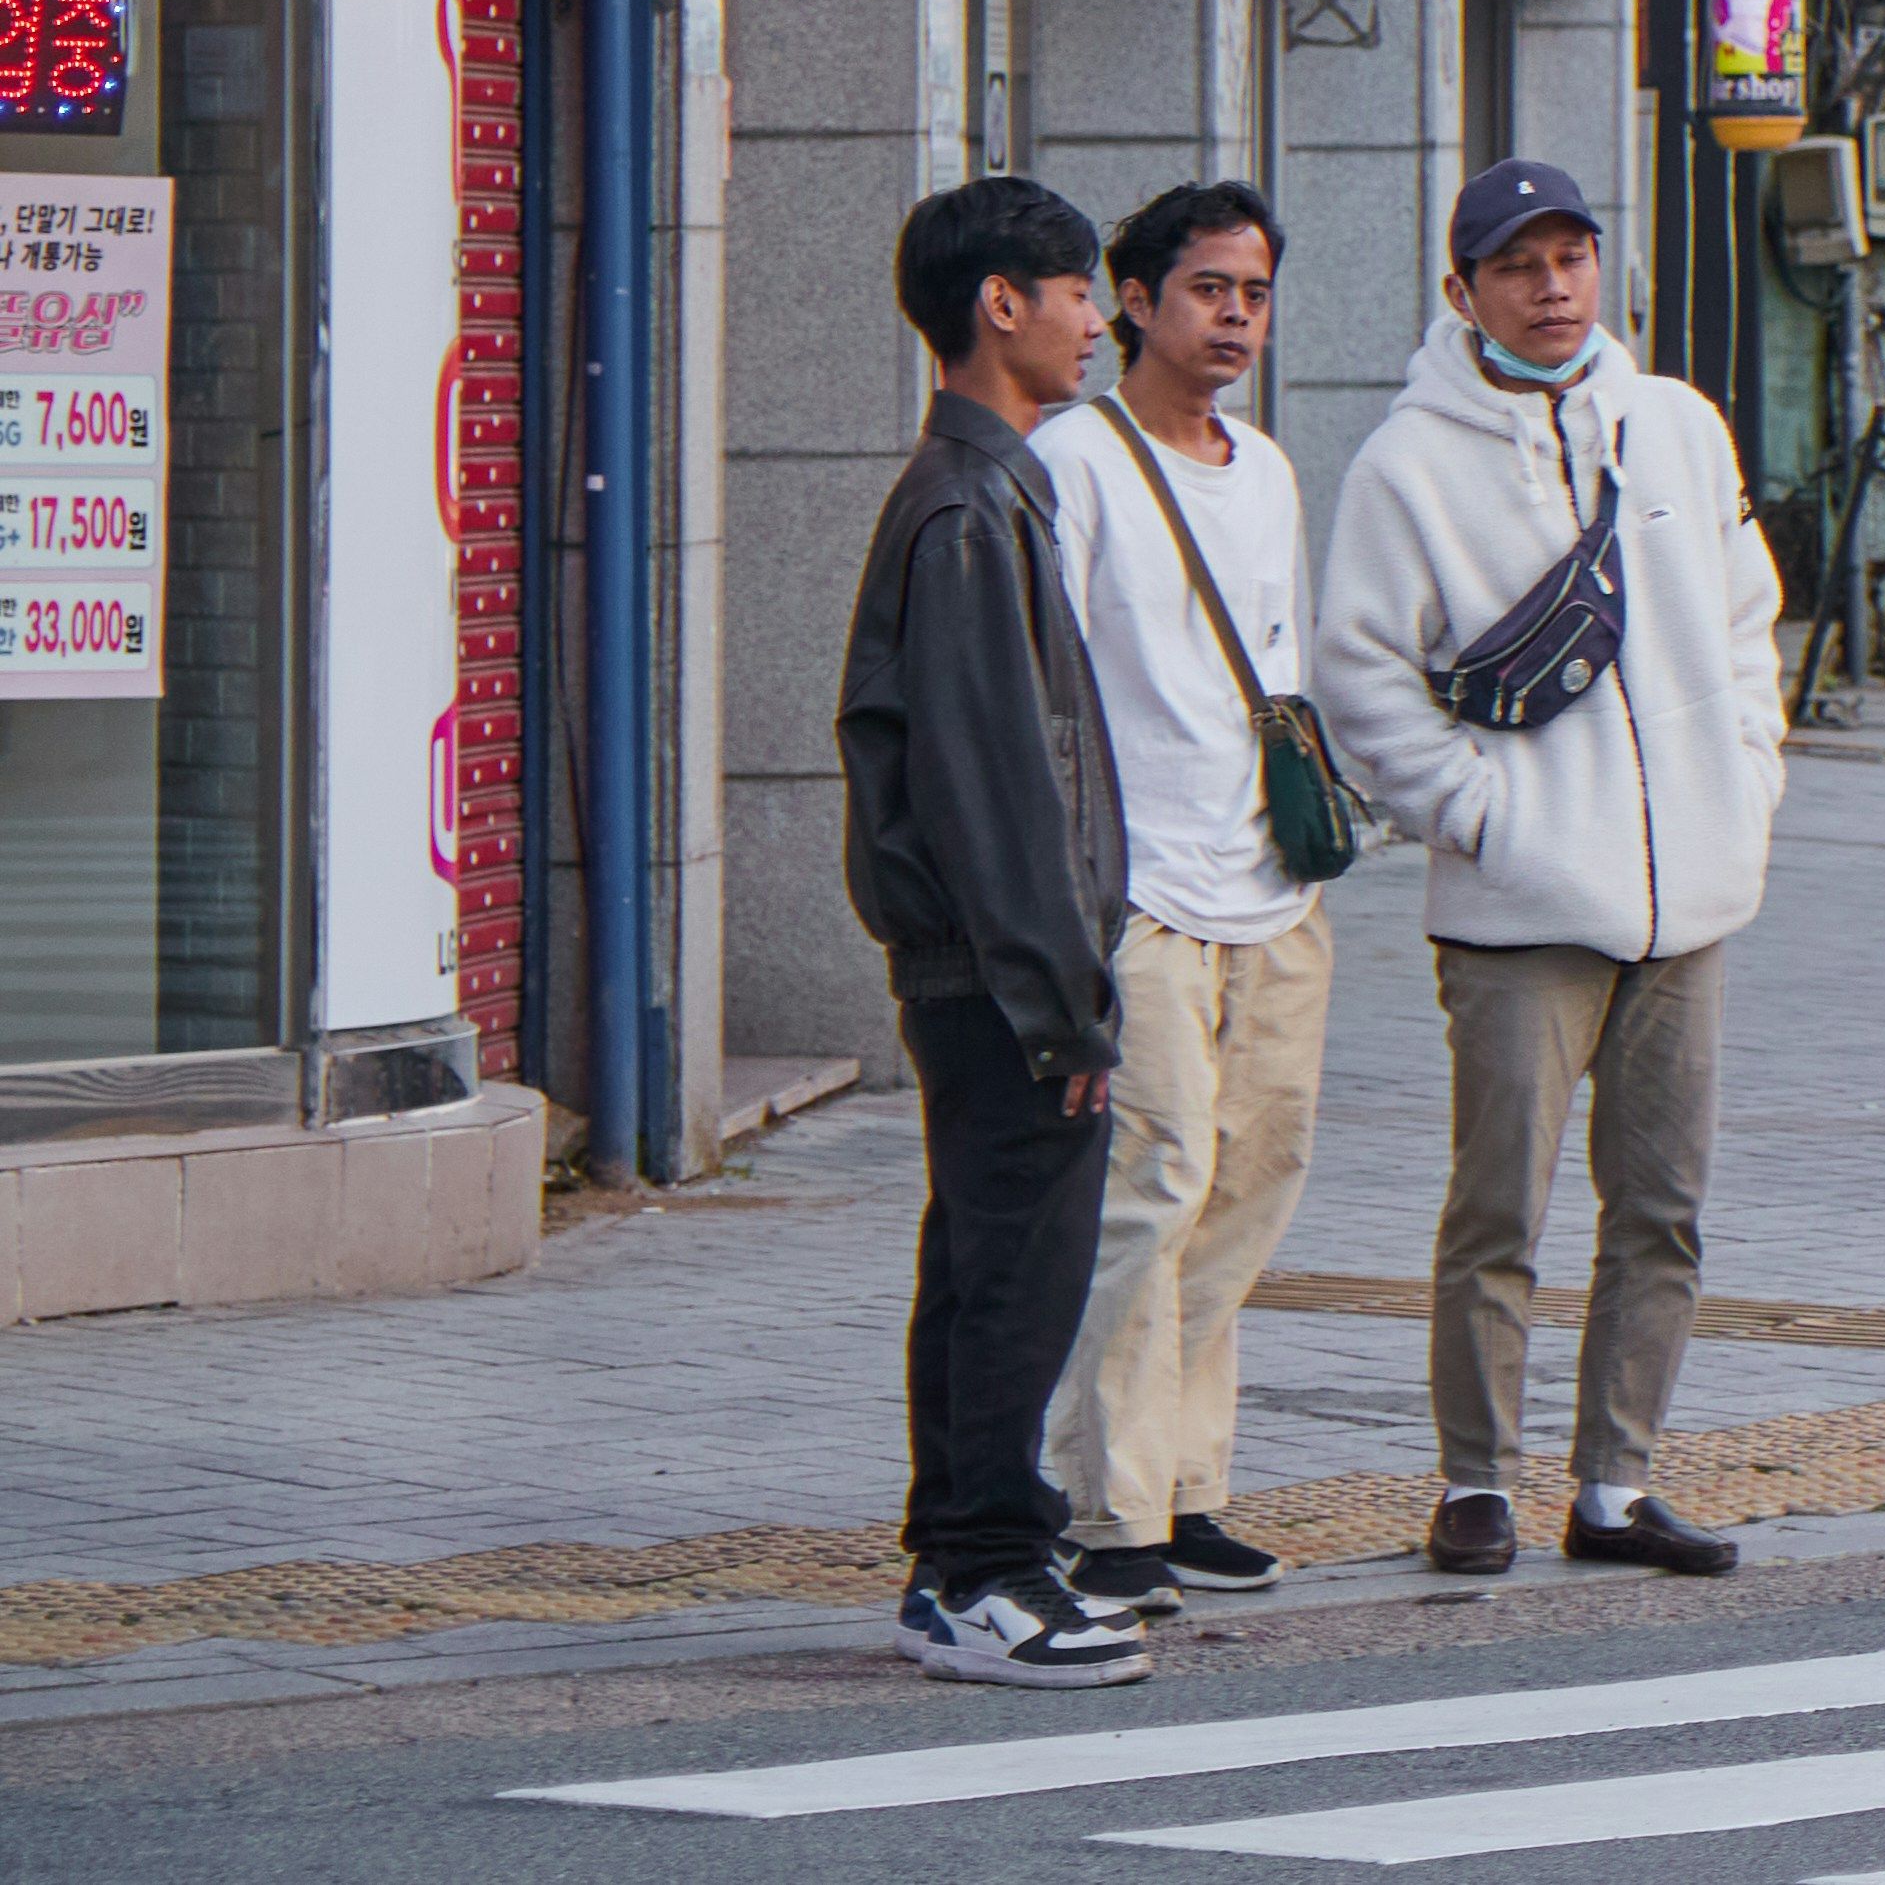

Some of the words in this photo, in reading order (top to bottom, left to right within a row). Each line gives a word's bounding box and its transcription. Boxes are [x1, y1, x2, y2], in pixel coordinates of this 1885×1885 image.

[16, 204, 77, 235] 단말기
[84, 205, 155, 235] 그대로!
[21, 241, 103, 273] 개통가능
[36, 391, 149, 451] 7,600원
[30, 497, 148, 555] 17,500원
[24, 601, 144, 659] 33,000원
